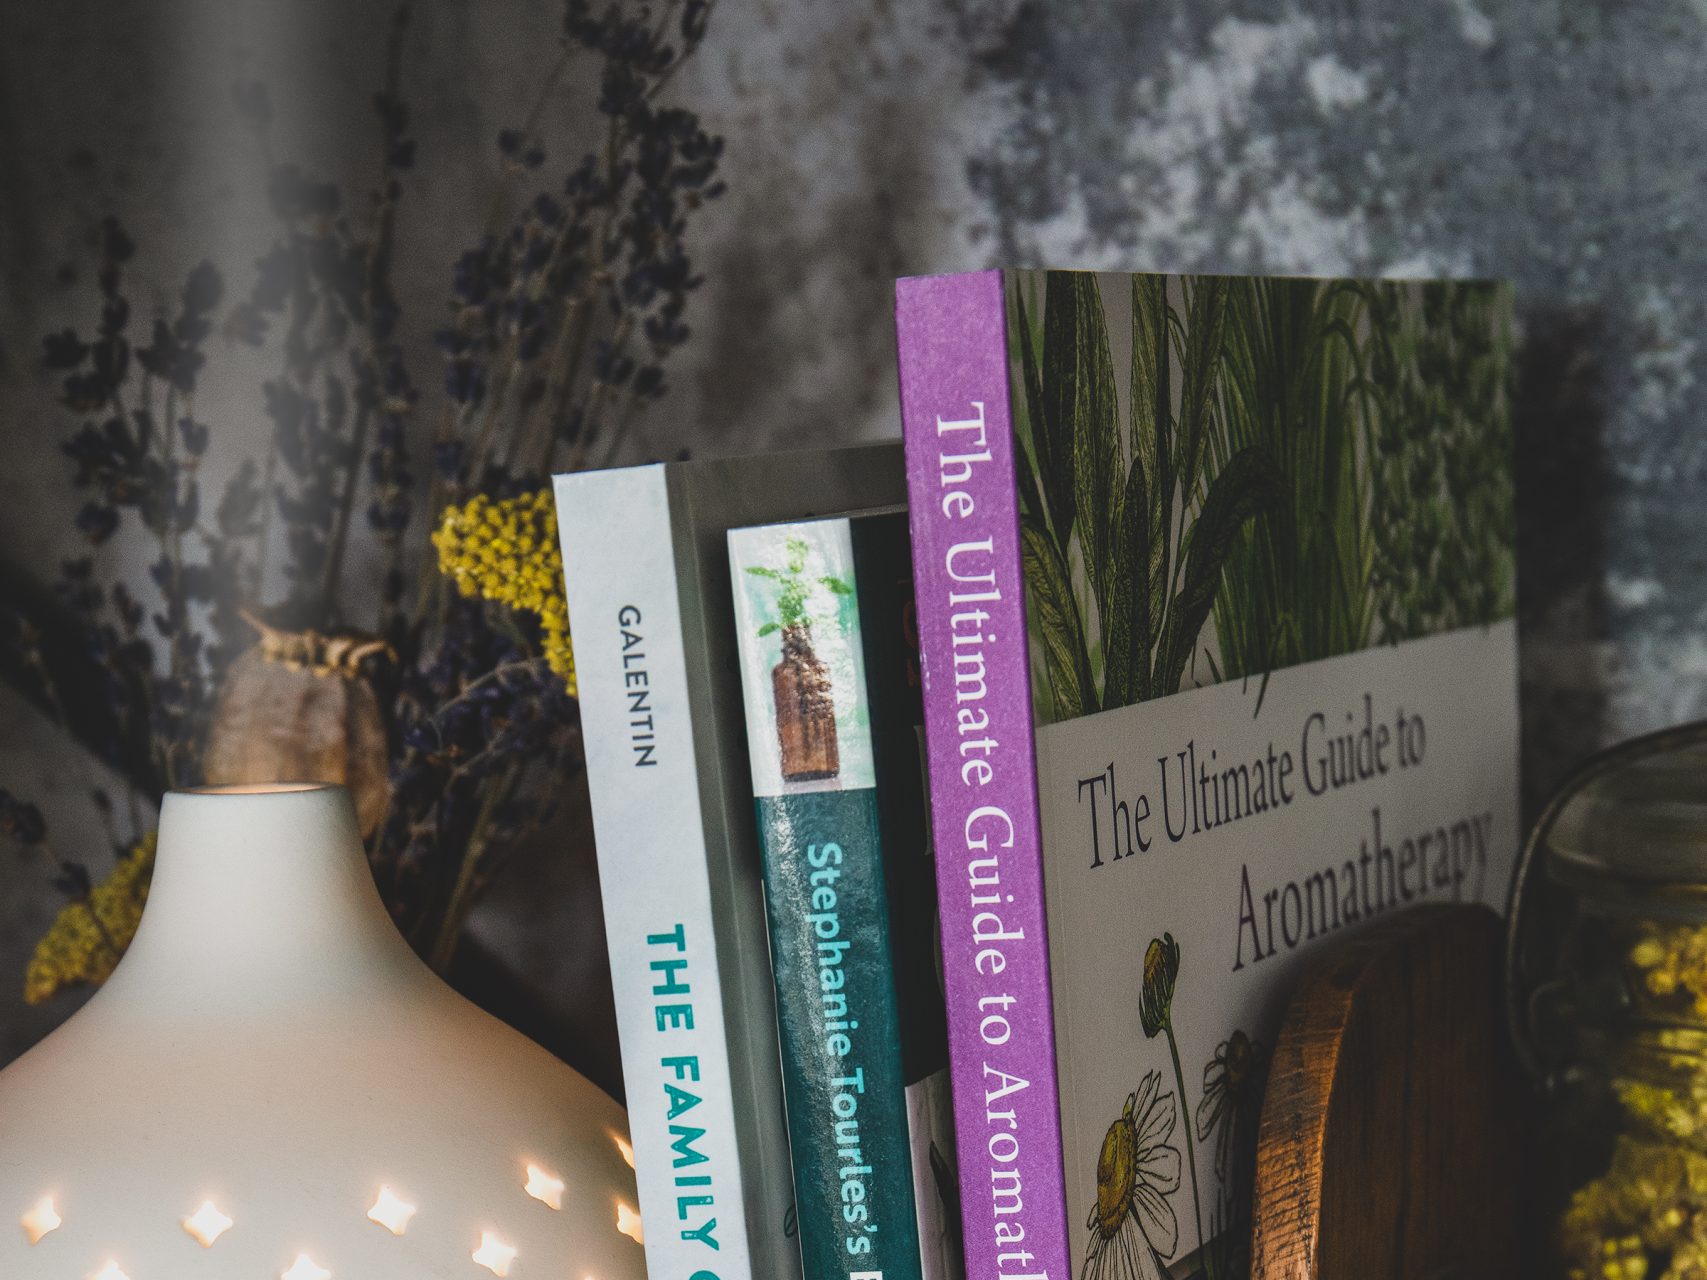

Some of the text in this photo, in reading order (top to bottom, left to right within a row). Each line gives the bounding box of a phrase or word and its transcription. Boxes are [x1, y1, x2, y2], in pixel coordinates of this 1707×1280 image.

[936, 400, 993, 519] The
[618, 604, 658, 767] GALENTIN
[945, 535, 1002, 786] Ultimate
[1077, 691, 1427, 870] The Ultimate Guide to
[803, 842, 859, 1057] Stephanie
[964, 805, 1026, 975] Guide
[1232, 804, 1494, 972] Aromatherapy
[646, 923, 695, 1033] THE
[977, 992, 1017, 1046] to
[660, 1055, 720, 1251] FAMILY
[830, 1067, 878, 1256] Tourles's
